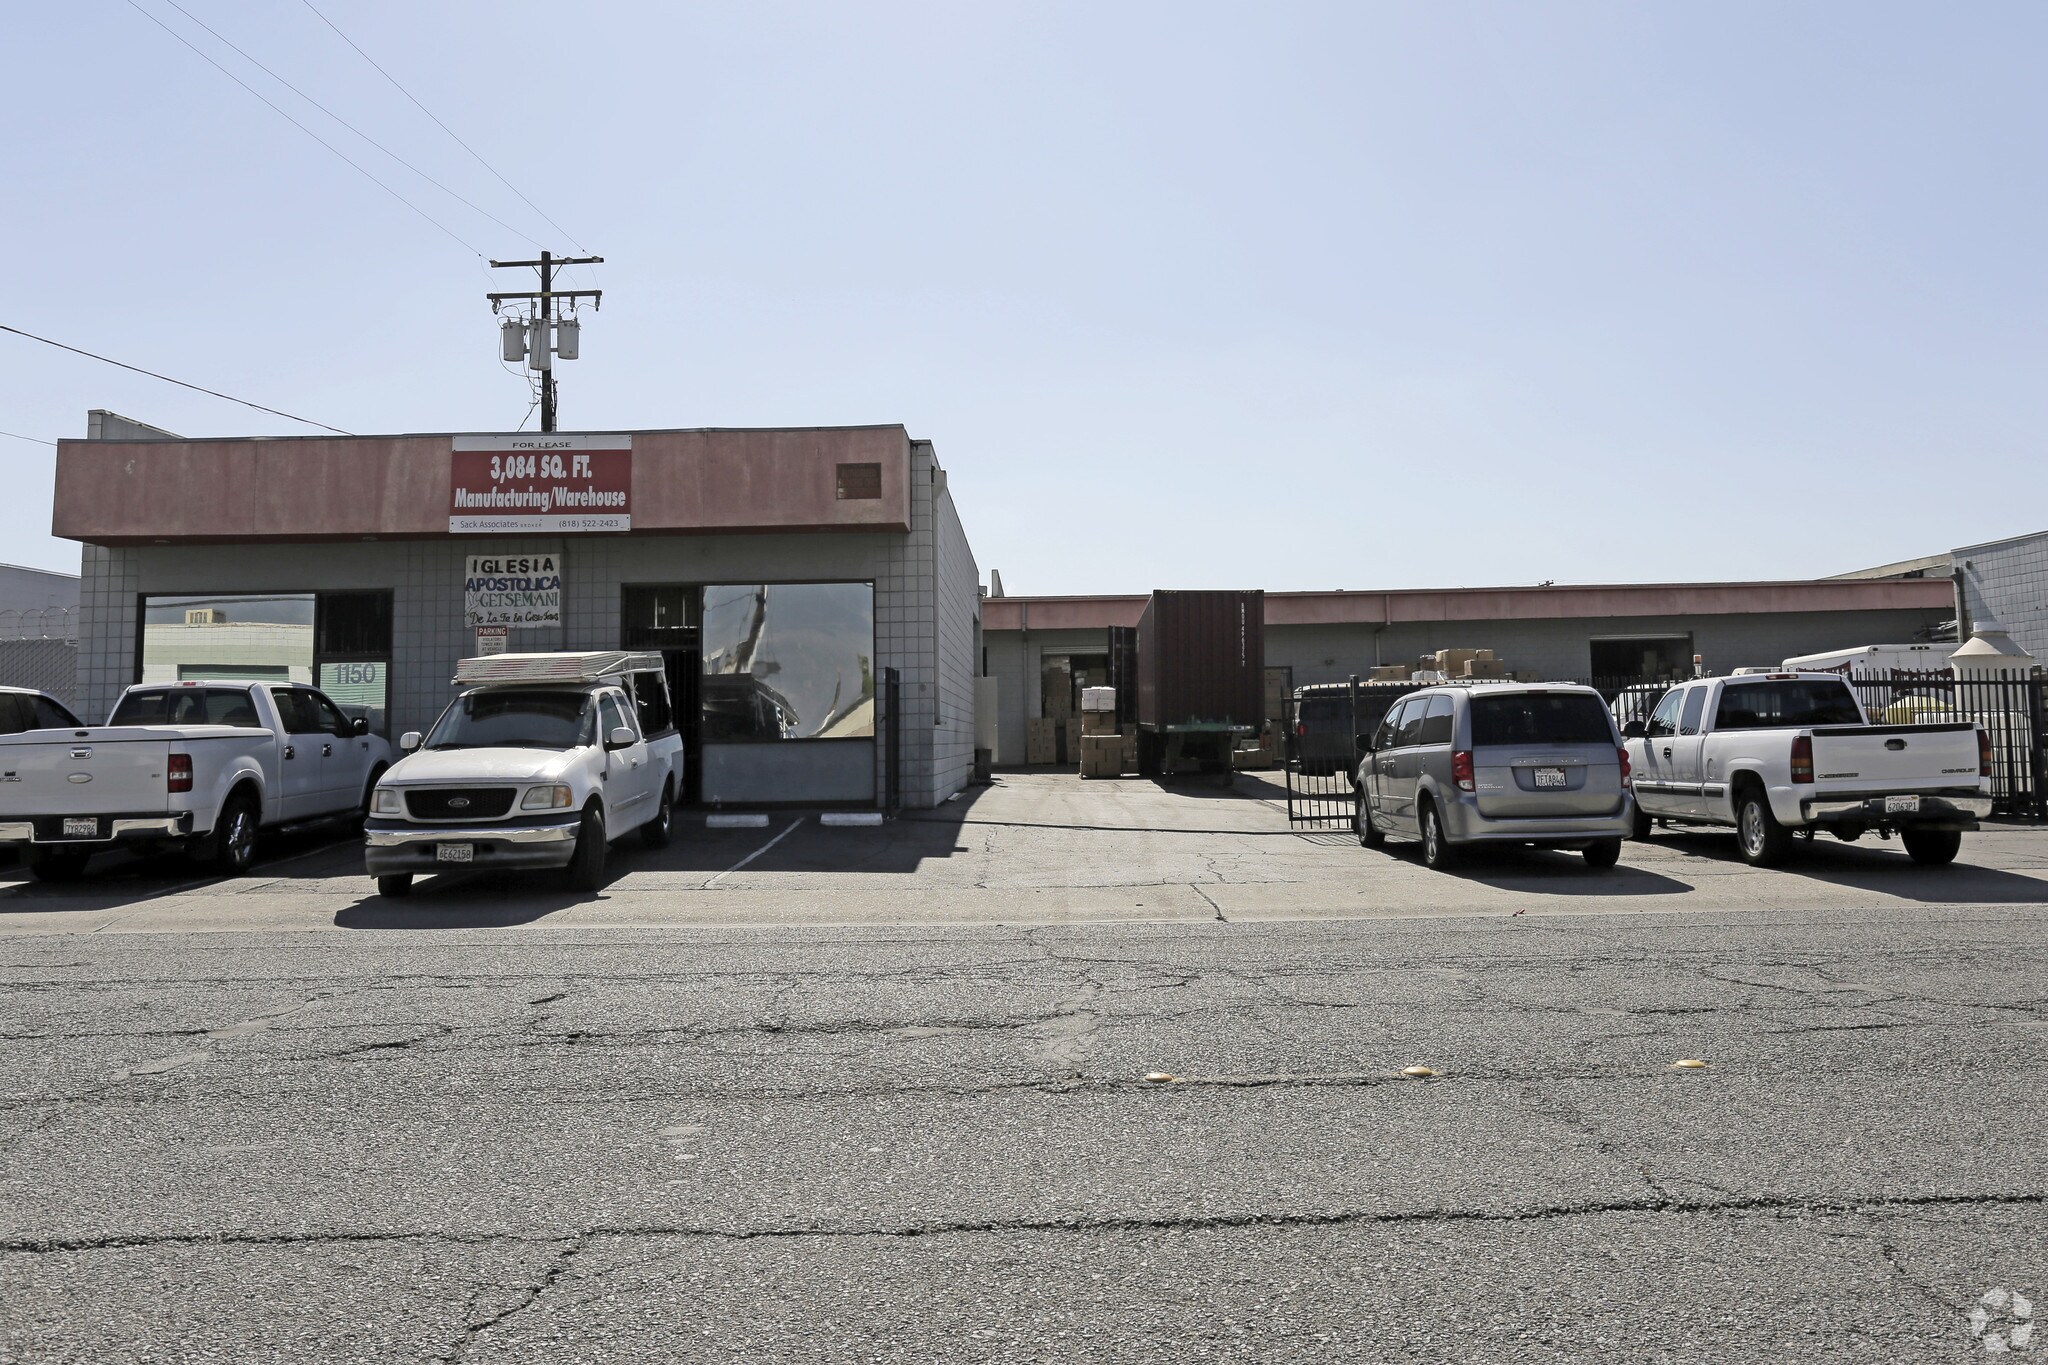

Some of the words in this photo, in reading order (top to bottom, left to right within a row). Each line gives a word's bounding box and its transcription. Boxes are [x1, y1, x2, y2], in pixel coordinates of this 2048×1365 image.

[490, 455, 536, 483] 3,084
[540, 454, 567, 479] SQ.
[572, 454, 593, 478] FT.
[454, 485, 626, 512] Manufacturing/Warehouse
[460, 520, 478, 529] Sack
[479, 520, 519, 528] Associates
[558, 519, 580, 528] (818)
[581, 519, 619, 527] 522-2423
[473, 558, 554, 573] IGLESIA
[465, 576, 560, 592] APOSTOLICA
[480, 592, 559, 608] GETSEMANI
[470, 611, 484, 625] De
[486, 611, 498, 623] La
[478, 627, 506, 635] PARKING
[334, 662, 376, 684] 1150
[1887, 801, 1917, 812] 62063P1
